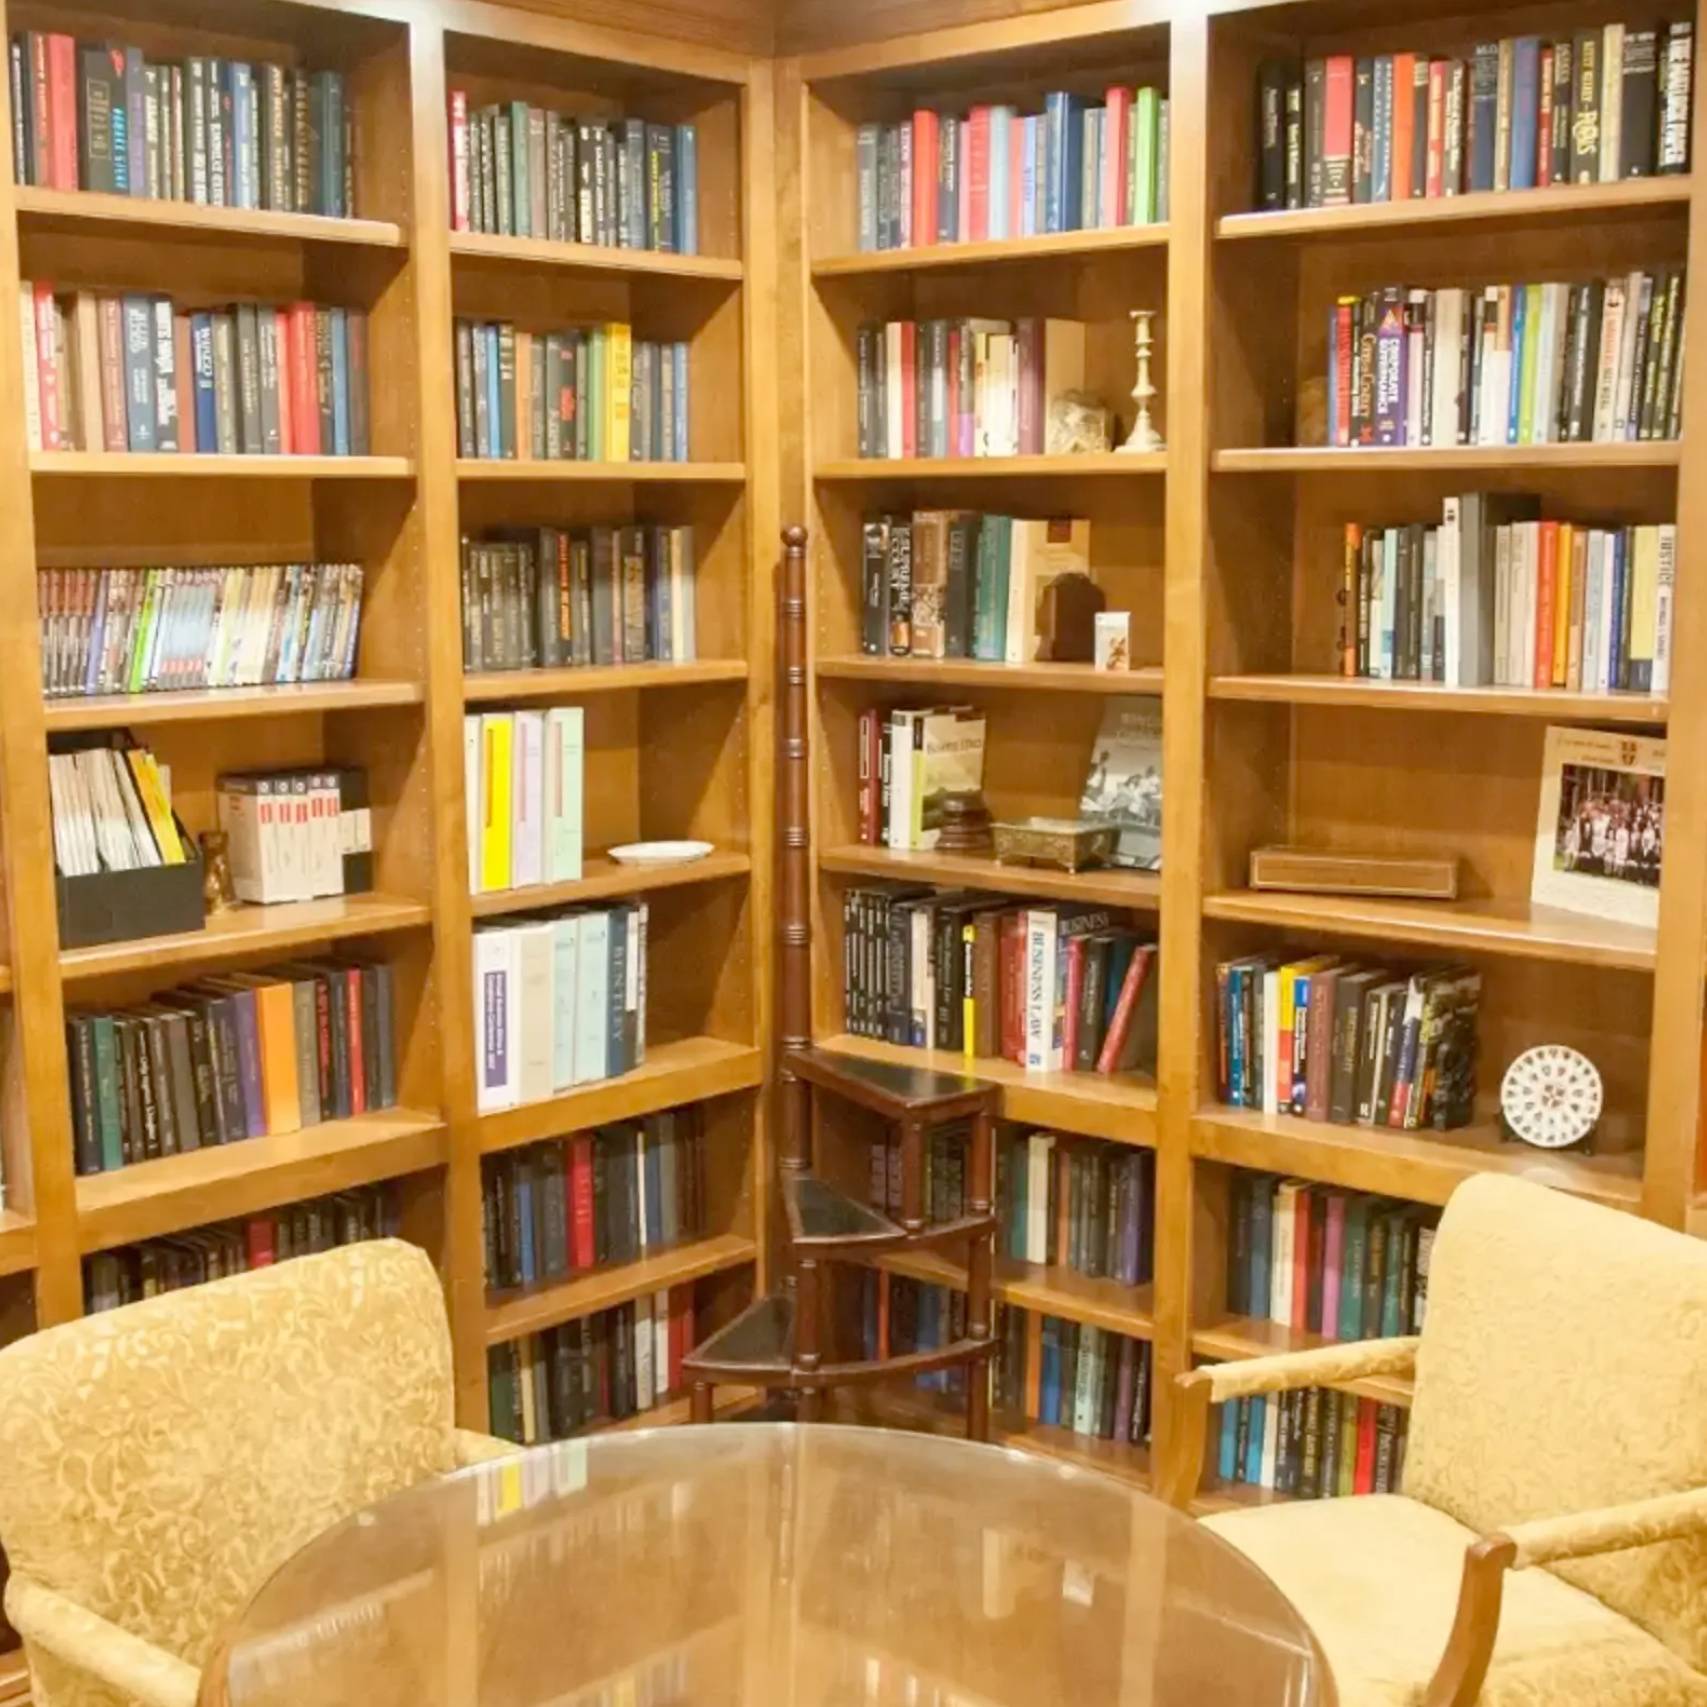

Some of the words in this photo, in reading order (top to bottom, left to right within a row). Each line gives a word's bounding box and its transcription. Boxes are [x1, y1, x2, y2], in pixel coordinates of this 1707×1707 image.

[1377, 338, 1390, 414] GOVERNANCE
[1387, 338, 1400, 403] CORPORATE
[1658, 536, 1674, 587] JUSTICE
[611, 946, 624, 1041] BENTLEY
[1031, 931, 1045, 1001] BUSINESS
[1030, 1005, 1043, 1039] LAW
